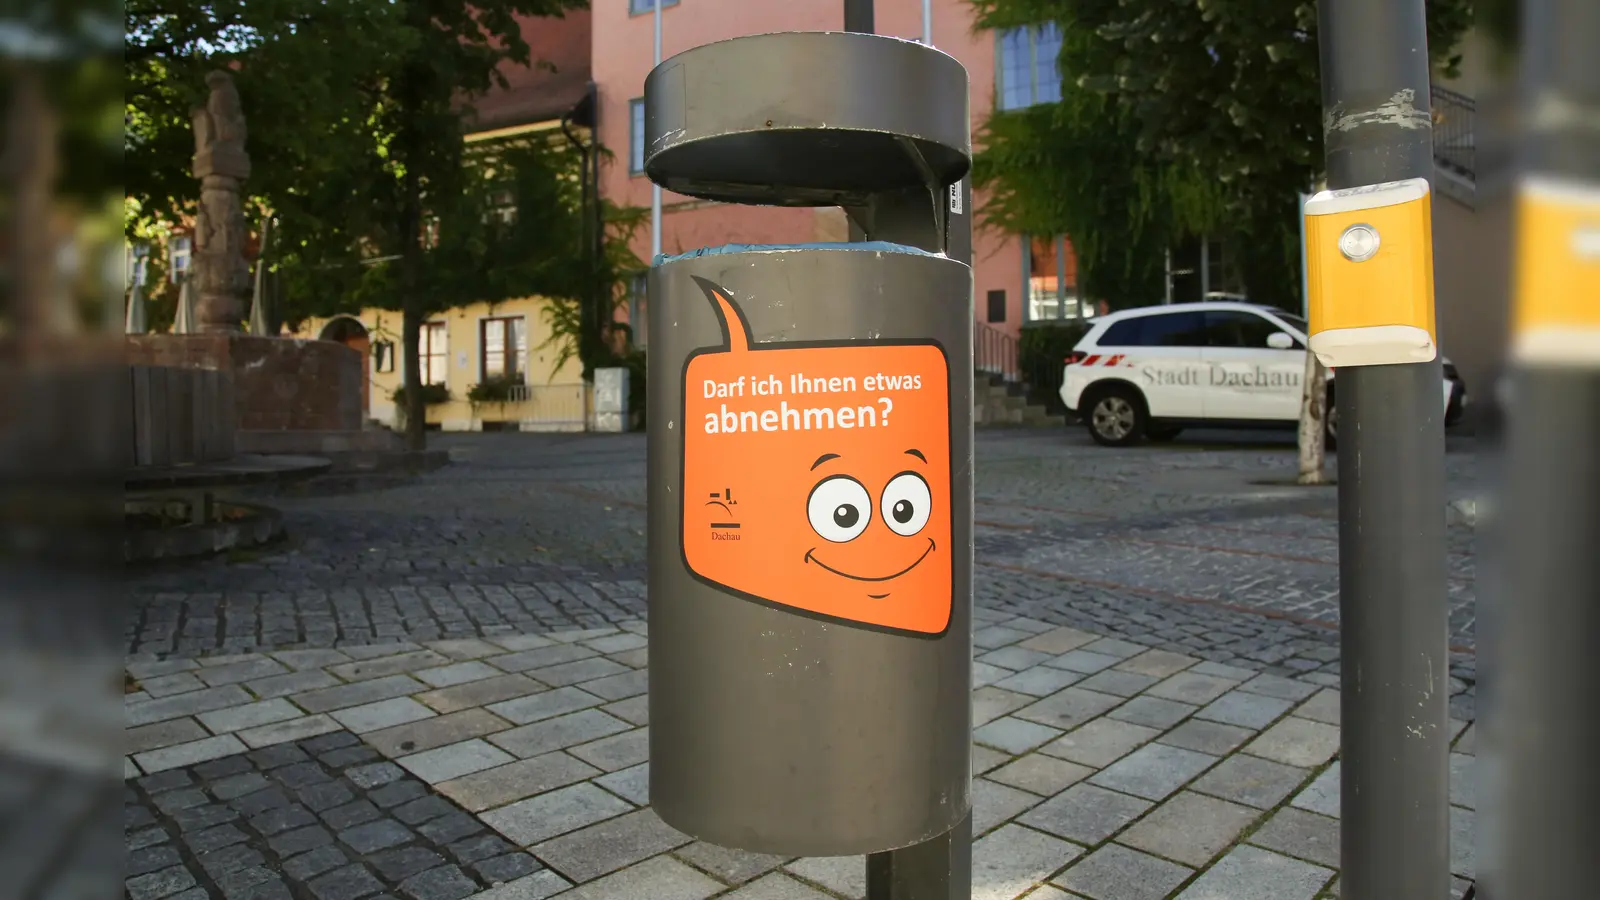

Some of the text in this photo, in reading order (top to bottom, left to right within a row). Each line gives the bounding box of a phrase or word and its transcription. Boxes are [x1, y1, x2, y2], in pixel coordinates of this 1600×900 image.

[703, 372, 922, 399] Darf ich Ihnen etwas
[1142, 364, 1300, 388] Stadt Dachau
[704, 397, 893, 434] abnehmen?
[711, 531, 741, 541] Dachau
